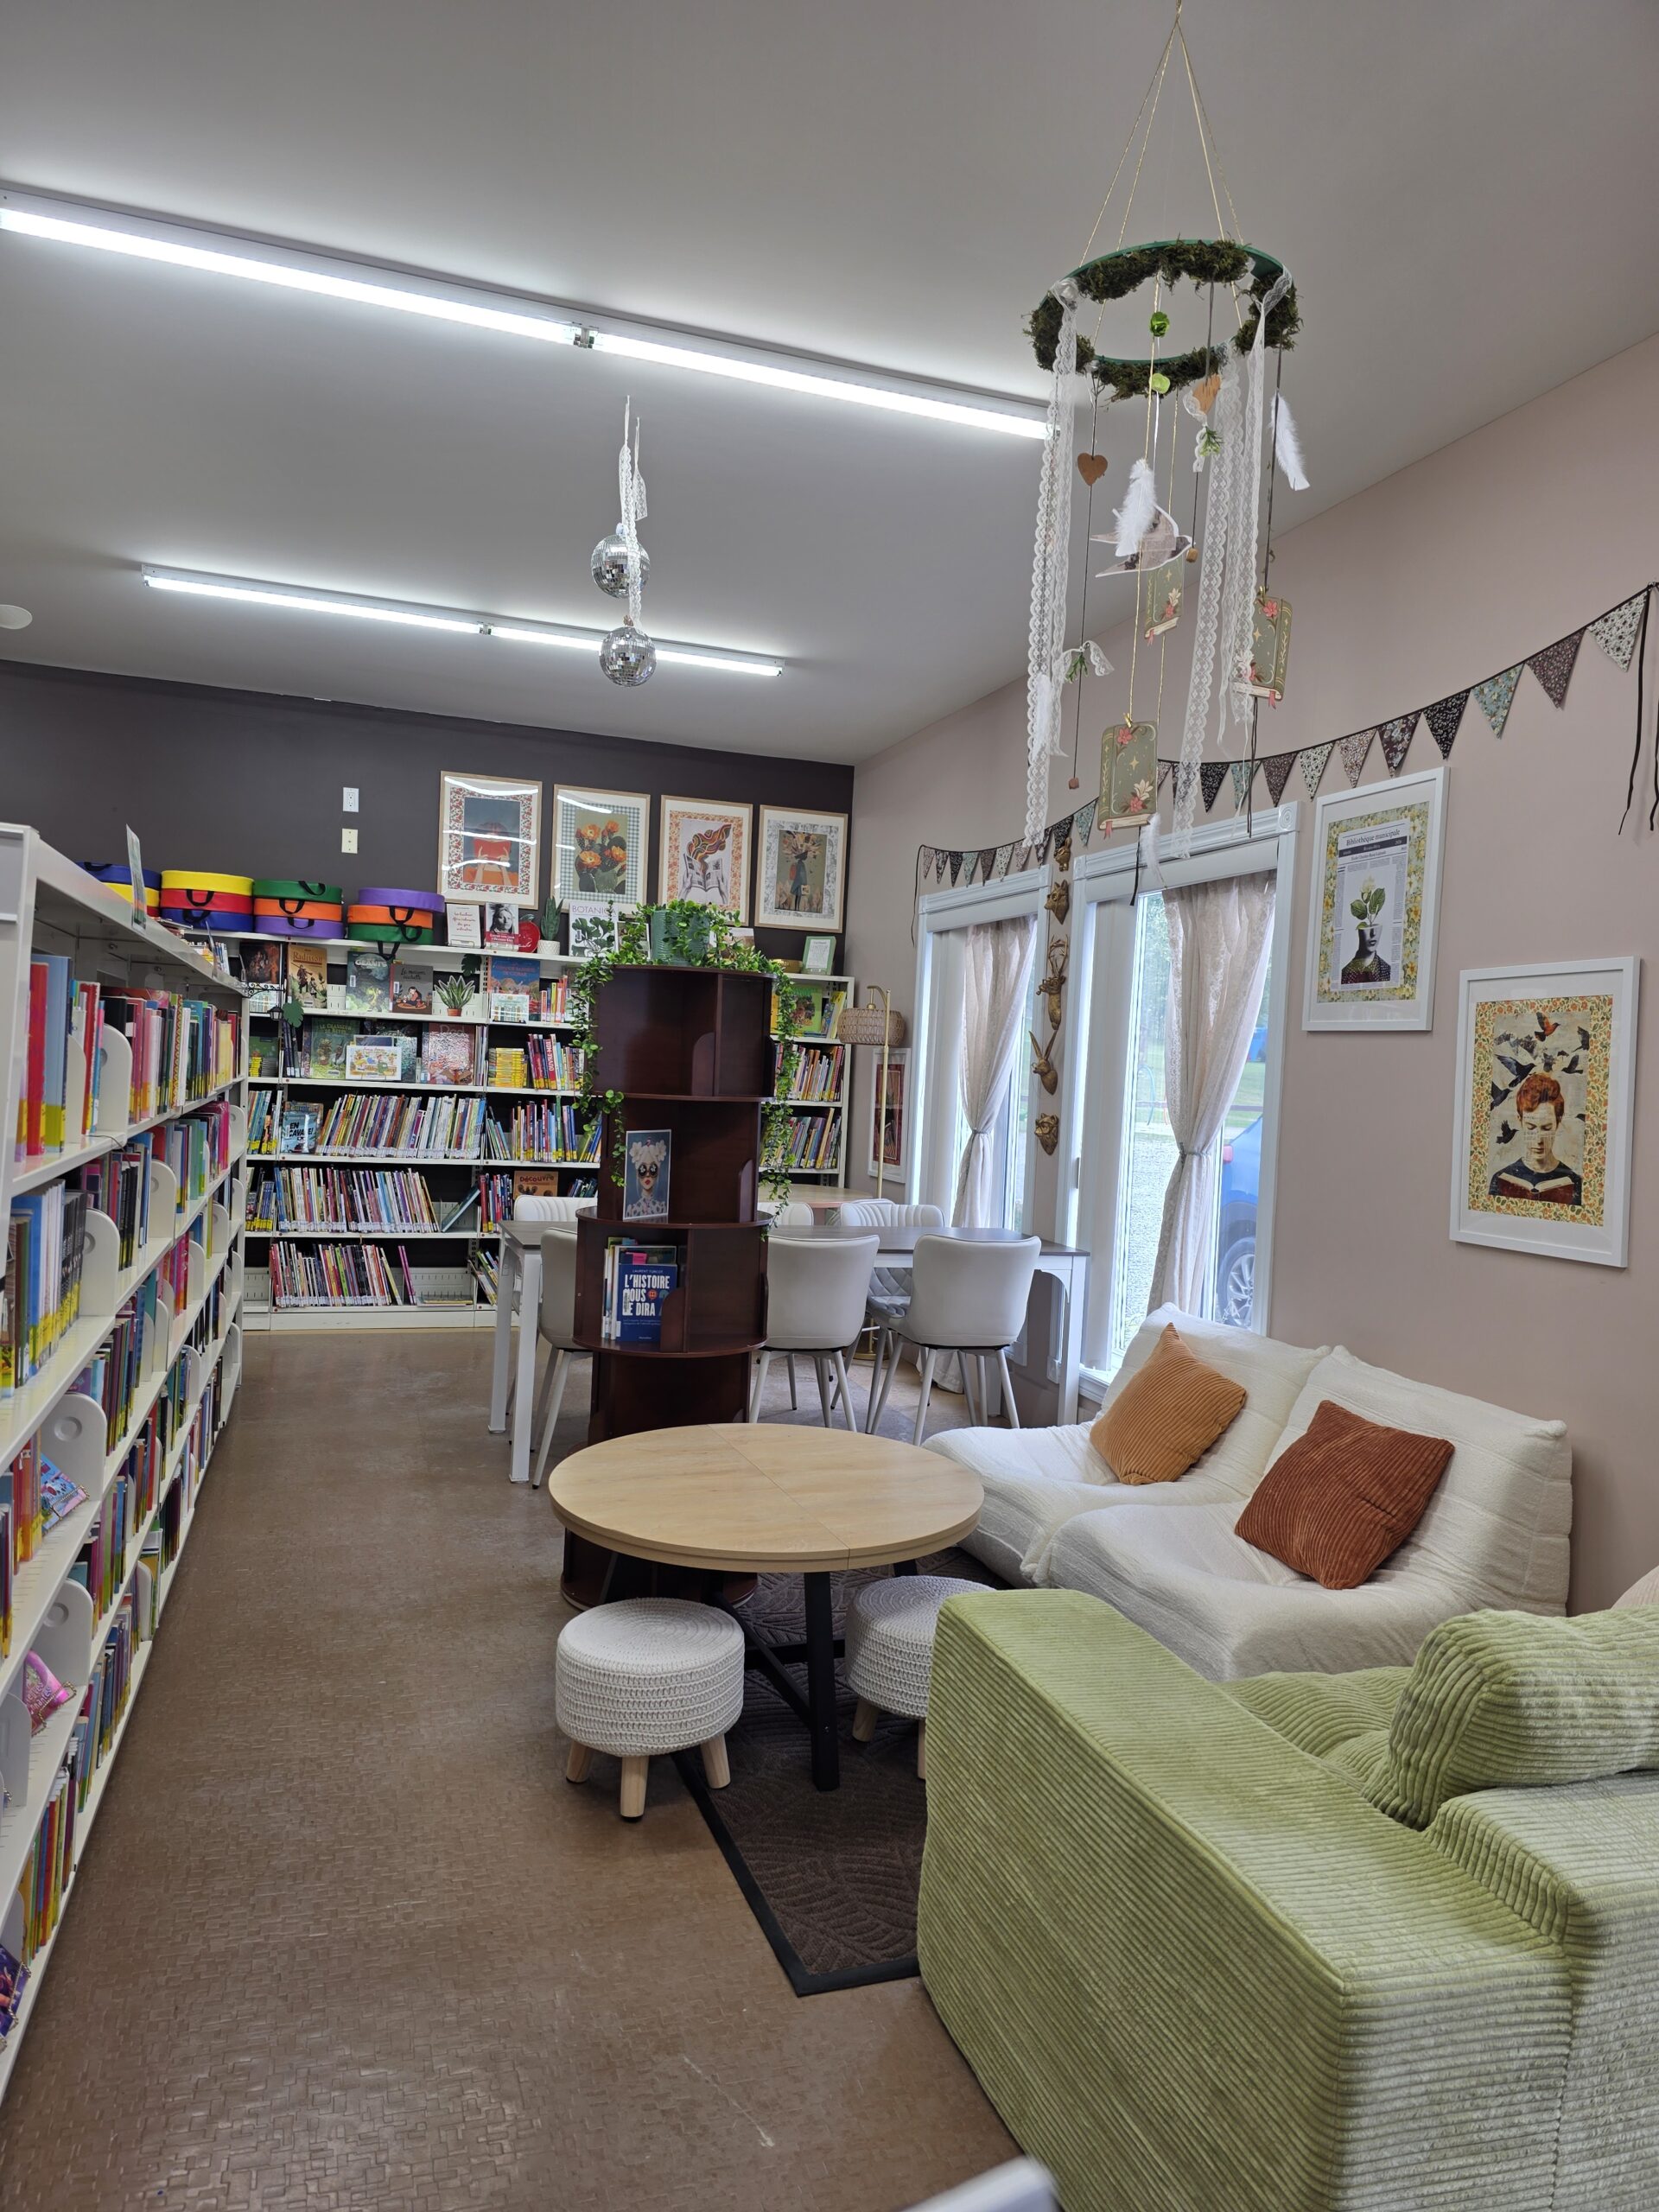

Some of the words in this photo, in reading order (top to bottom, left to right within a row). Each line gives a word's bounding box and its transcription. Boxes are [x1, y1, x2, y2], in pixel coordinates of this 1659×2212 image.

[293, 952, 323, 962] Radisson
[289, 1128, 315, 1137] CAVAE!
[625, 1274, 671, 1288] L'HISTOIRE
[635, 1302, 656, 1316] DIRA
